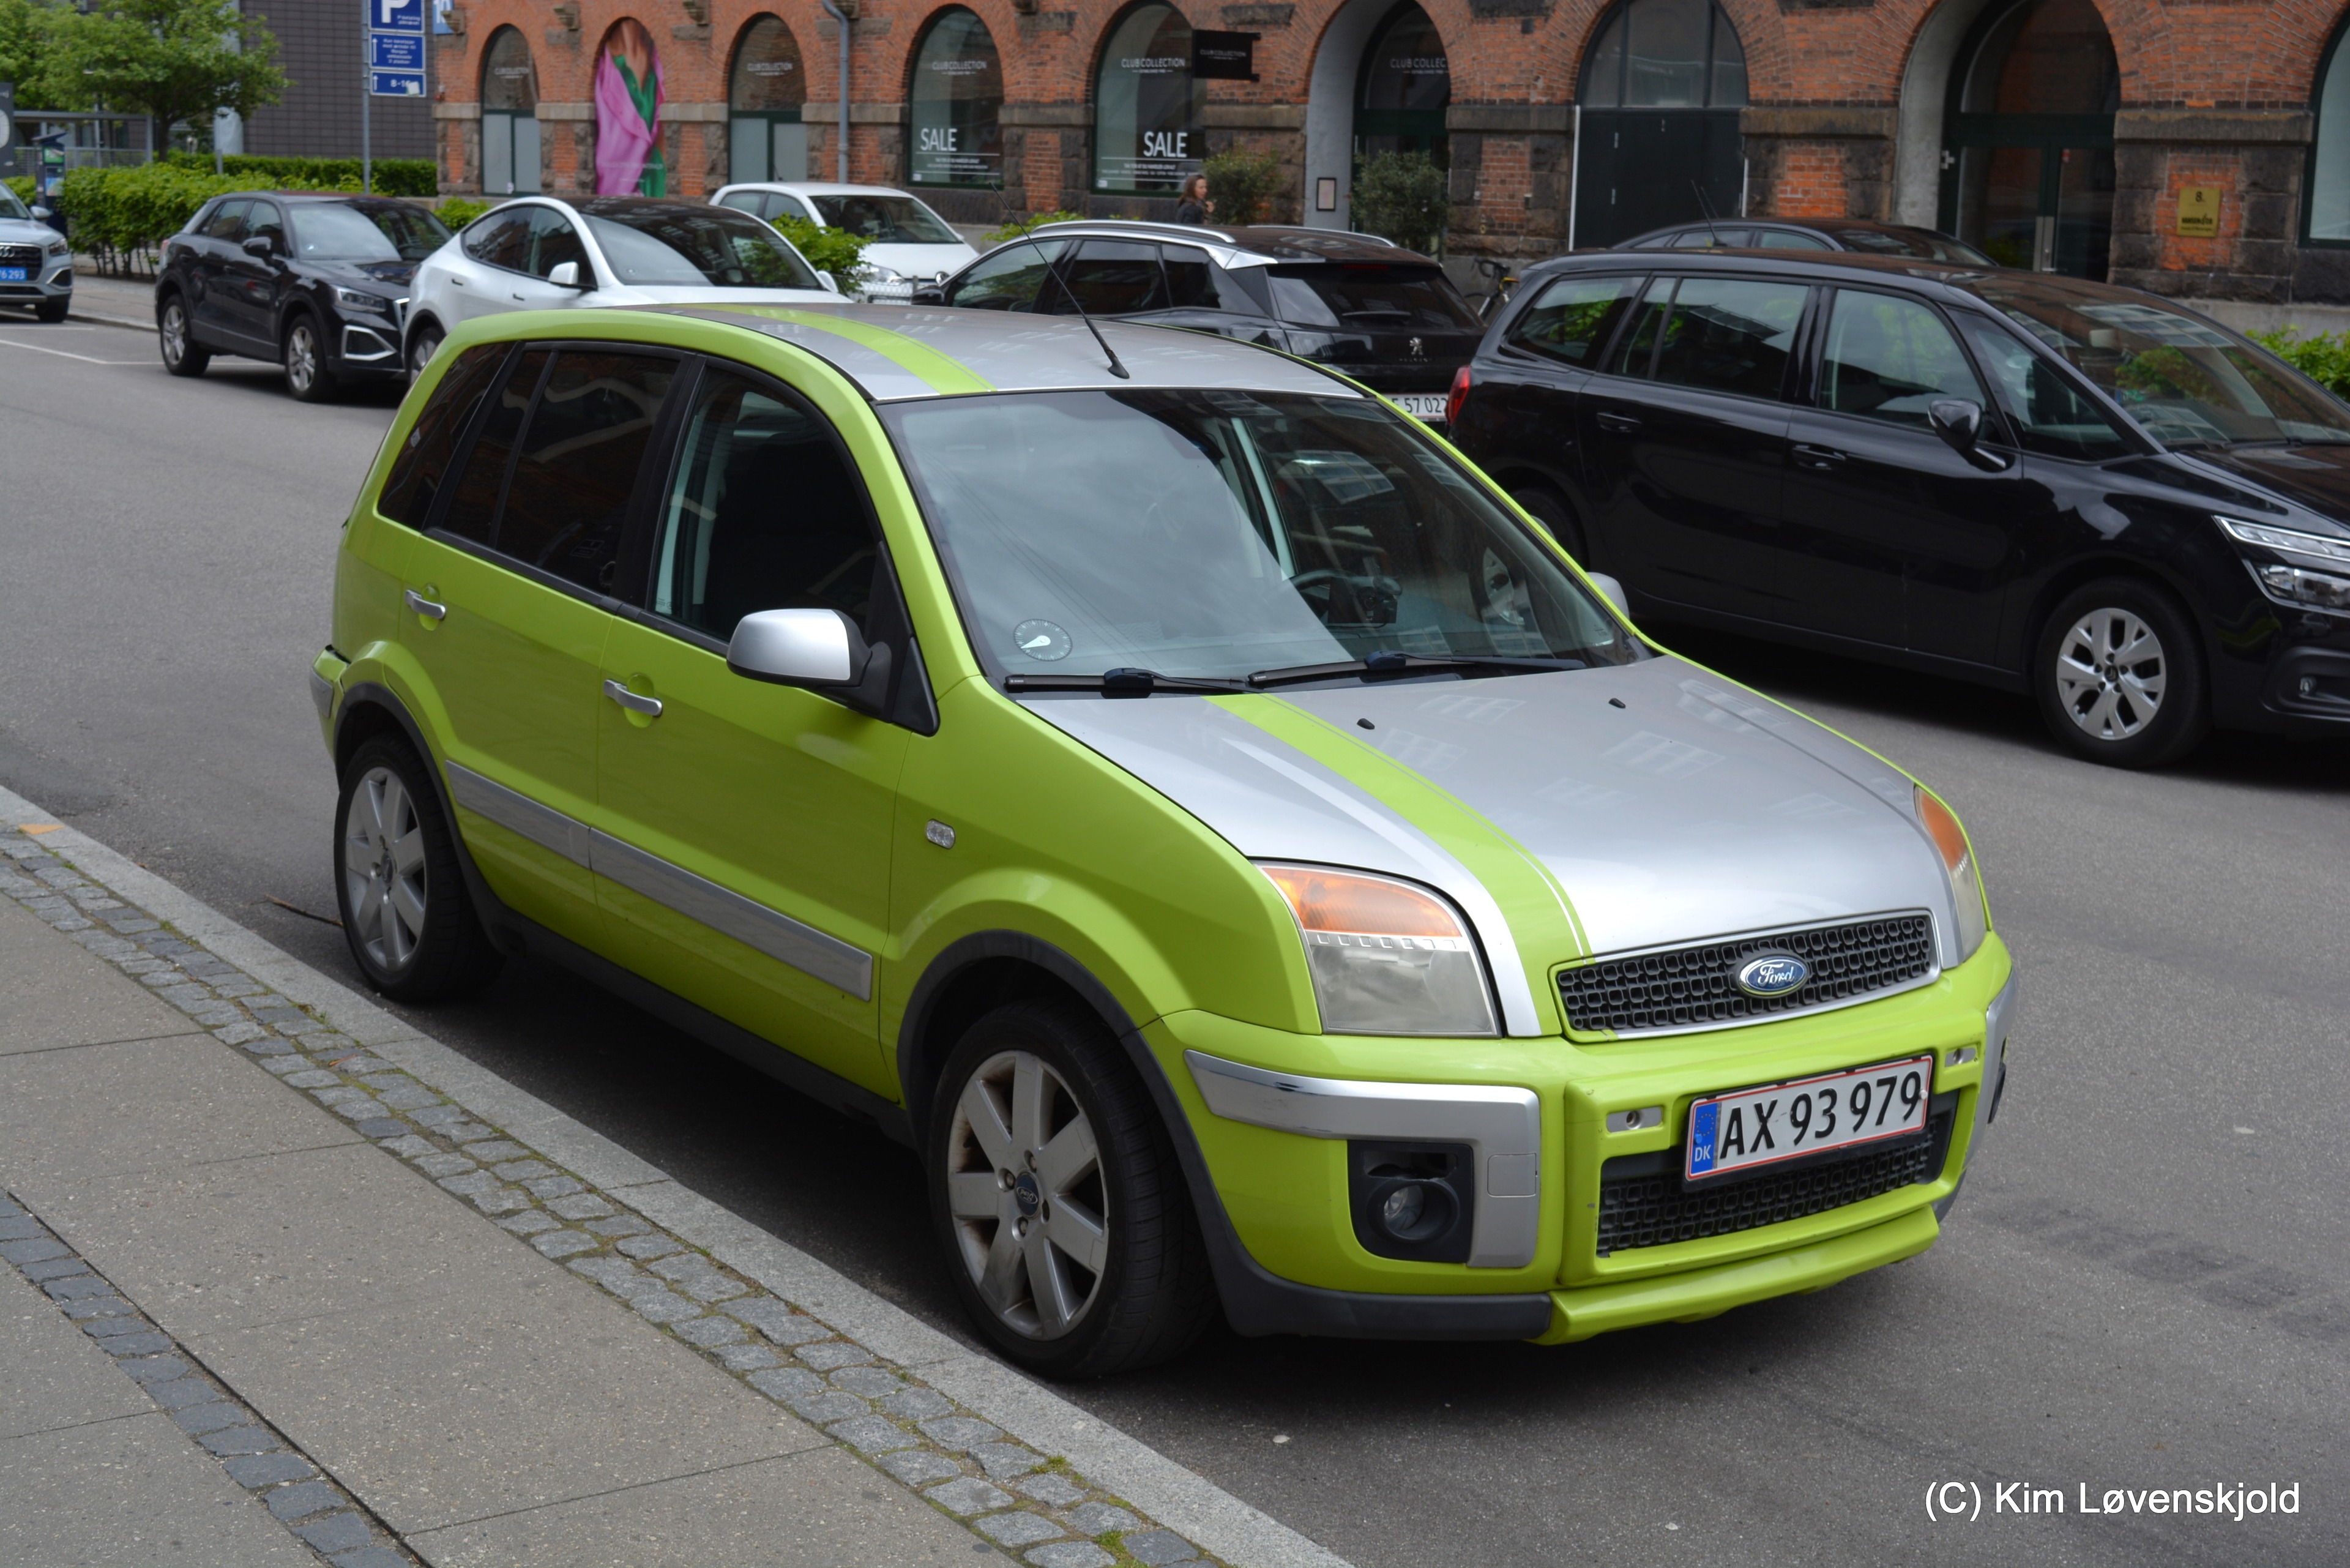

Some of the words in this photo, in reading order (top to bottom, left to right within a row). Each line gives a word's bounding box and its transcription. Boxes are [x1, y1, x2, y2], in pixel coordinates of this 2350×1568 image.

[381, 0, 411, 23] P
[920, 128, 957, 151] SALE
[1143, 131, 1188, 158] SALE
[8, 270, 25, 280] 293
[1404, 398, 1419, 413] 57
[1758, 963, 1794, 987] Ford
[1720, 1099, 1778, 1159] AX
[1790, 1088, 1837, 1146] 93
[1850, 1071, 1922, 1133] 979
[1694, 1144, 1711, 1163] DK
